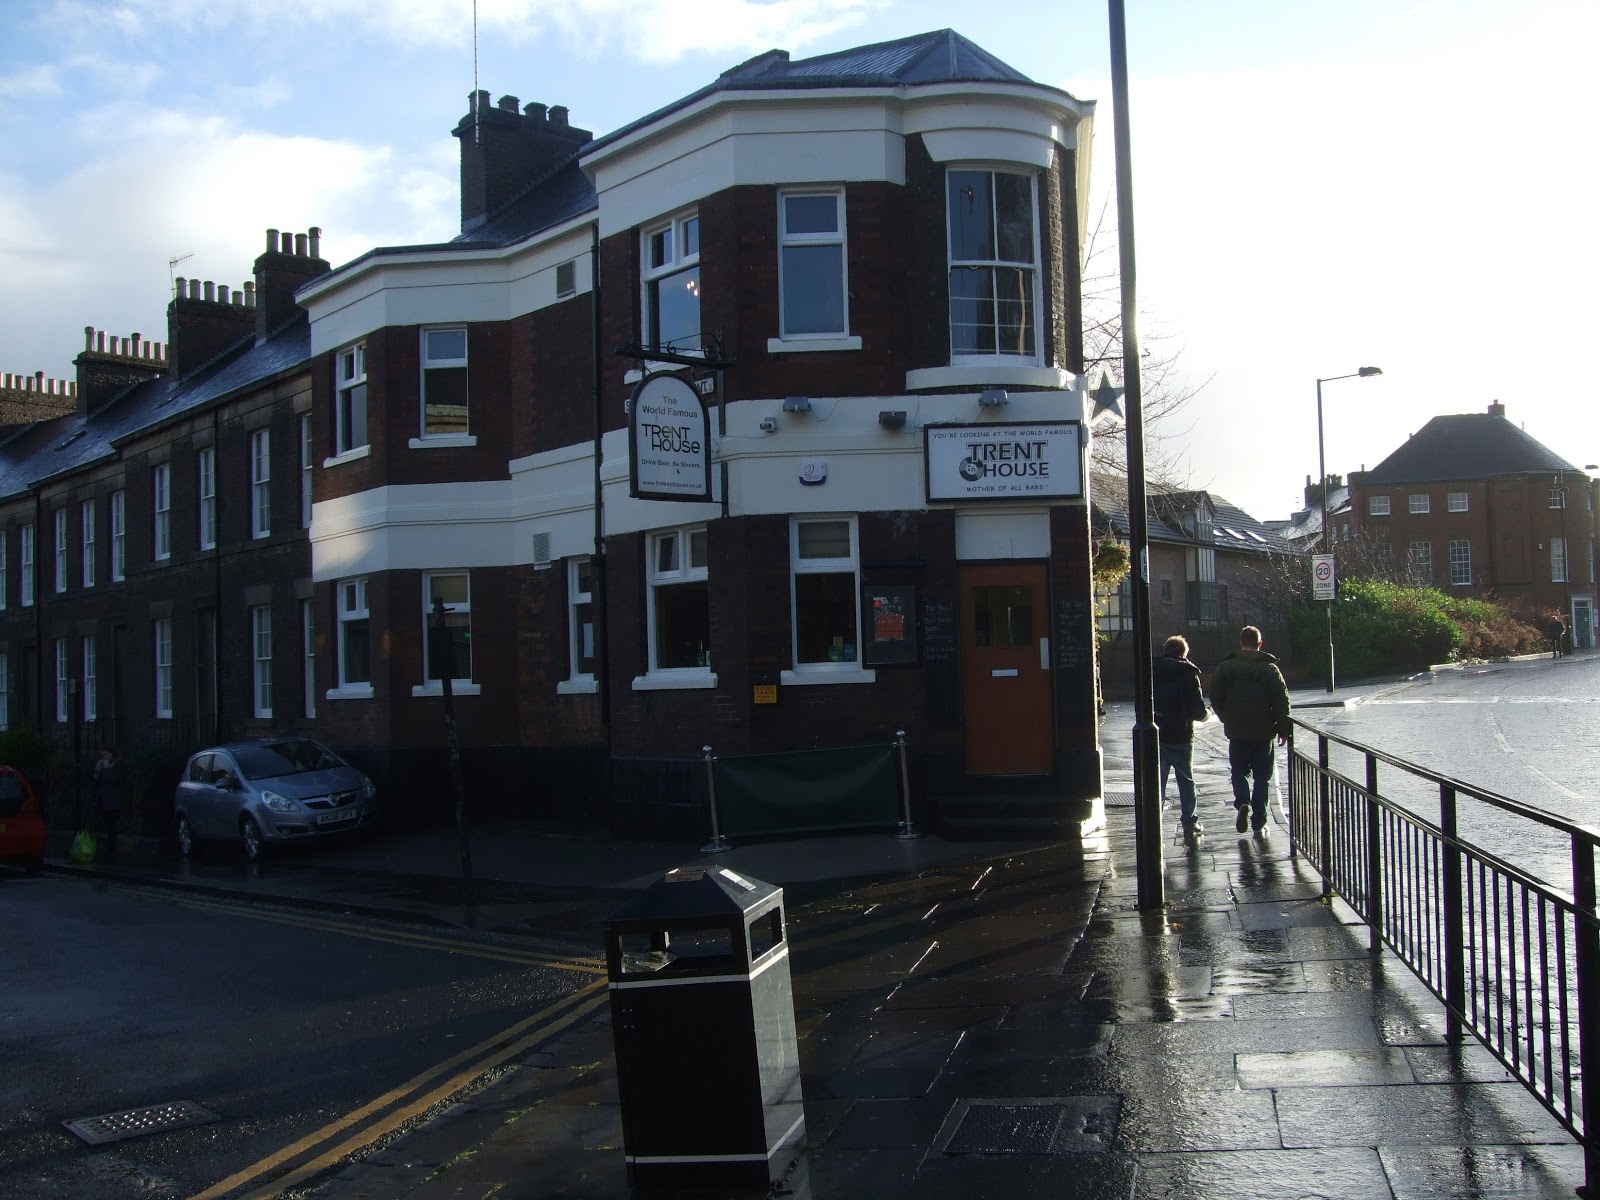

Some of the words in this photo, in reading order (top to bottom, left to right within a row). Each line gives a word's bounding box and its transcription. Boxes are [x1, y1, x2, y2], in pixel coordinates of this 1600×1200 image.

[663, 396, 677, 405] The
[642, 405, 665, 415] World
[668, 408, 698, 418] Famous
[967, 441, 1047, 461] TRENT
[983, 462, 1049, 477] HOUSE
[1318, 567, 1329, 575] 20
